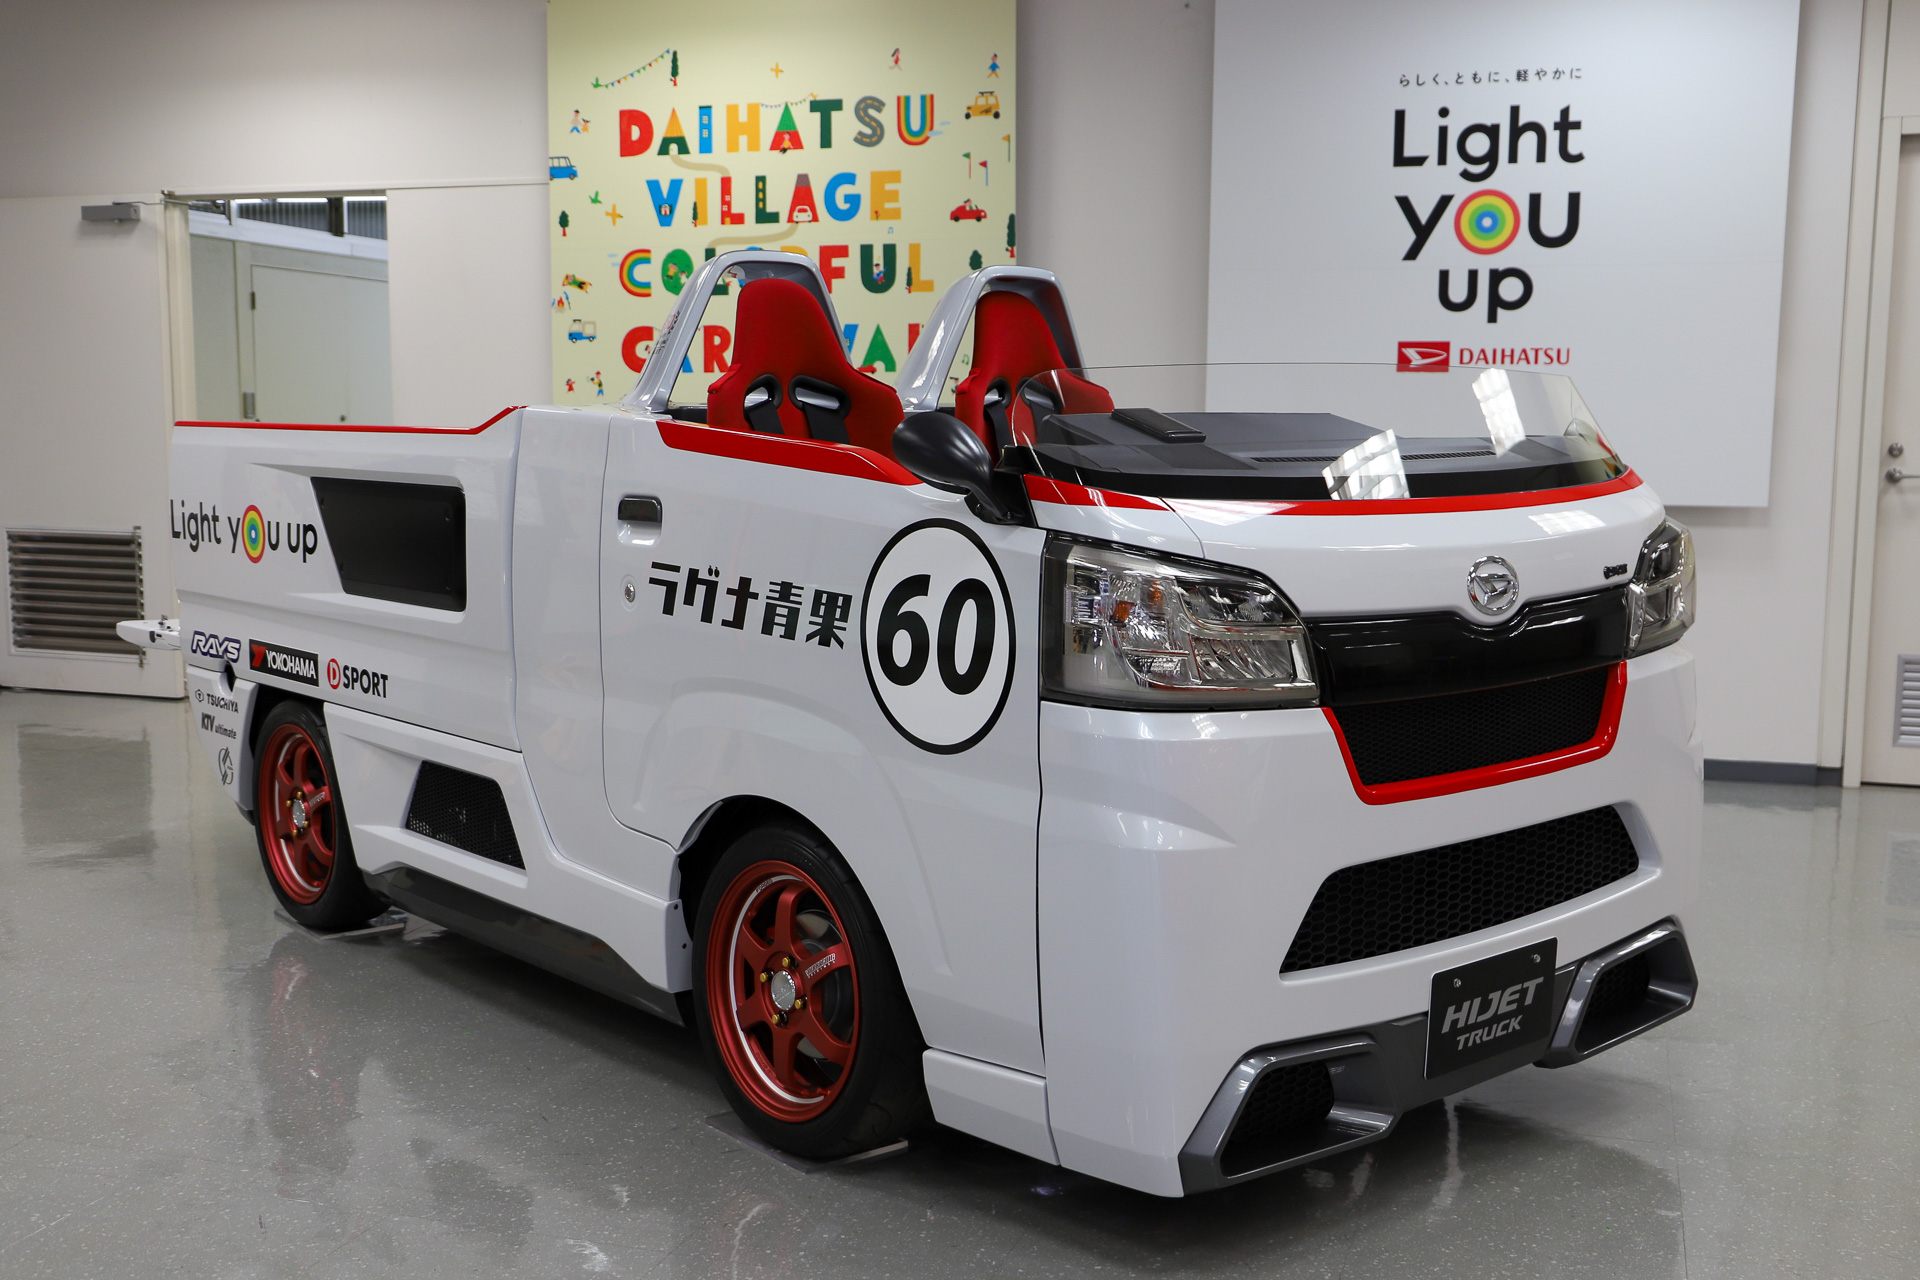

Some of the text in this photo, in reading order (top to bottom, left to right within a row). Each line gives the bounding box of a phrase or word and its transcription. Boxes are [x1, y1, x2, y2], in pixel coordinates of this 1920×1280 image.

[1399, 67, 1582, 87] らしく、ともに、軽やかに
[619, 94, 935, 157] DAIHATSU
[1393, 104, 1585, 182] Light
[646, 170, 902, 227] VILLAGE
[1438, 267, 1533, 323] up
[1459, 347, 1570, 366] DAIHATSU
[170, 499, 222, 552] Light
[287, 522, 318, 563] up
[648, 561, 853, 650] ラグナ青果
[192, 632, 241, 662] RAYS
[877, 574, 995, 695] 60
[265, 649, 317, 680] YOKOHAMA
[343, 664, 389, 698] SPORT
[206, 693, 239, 713] TSUCHIYA
[1441, 977, 1544, 1034] HIJET
[1456, 1015, 1523, 1050] TRUCK
